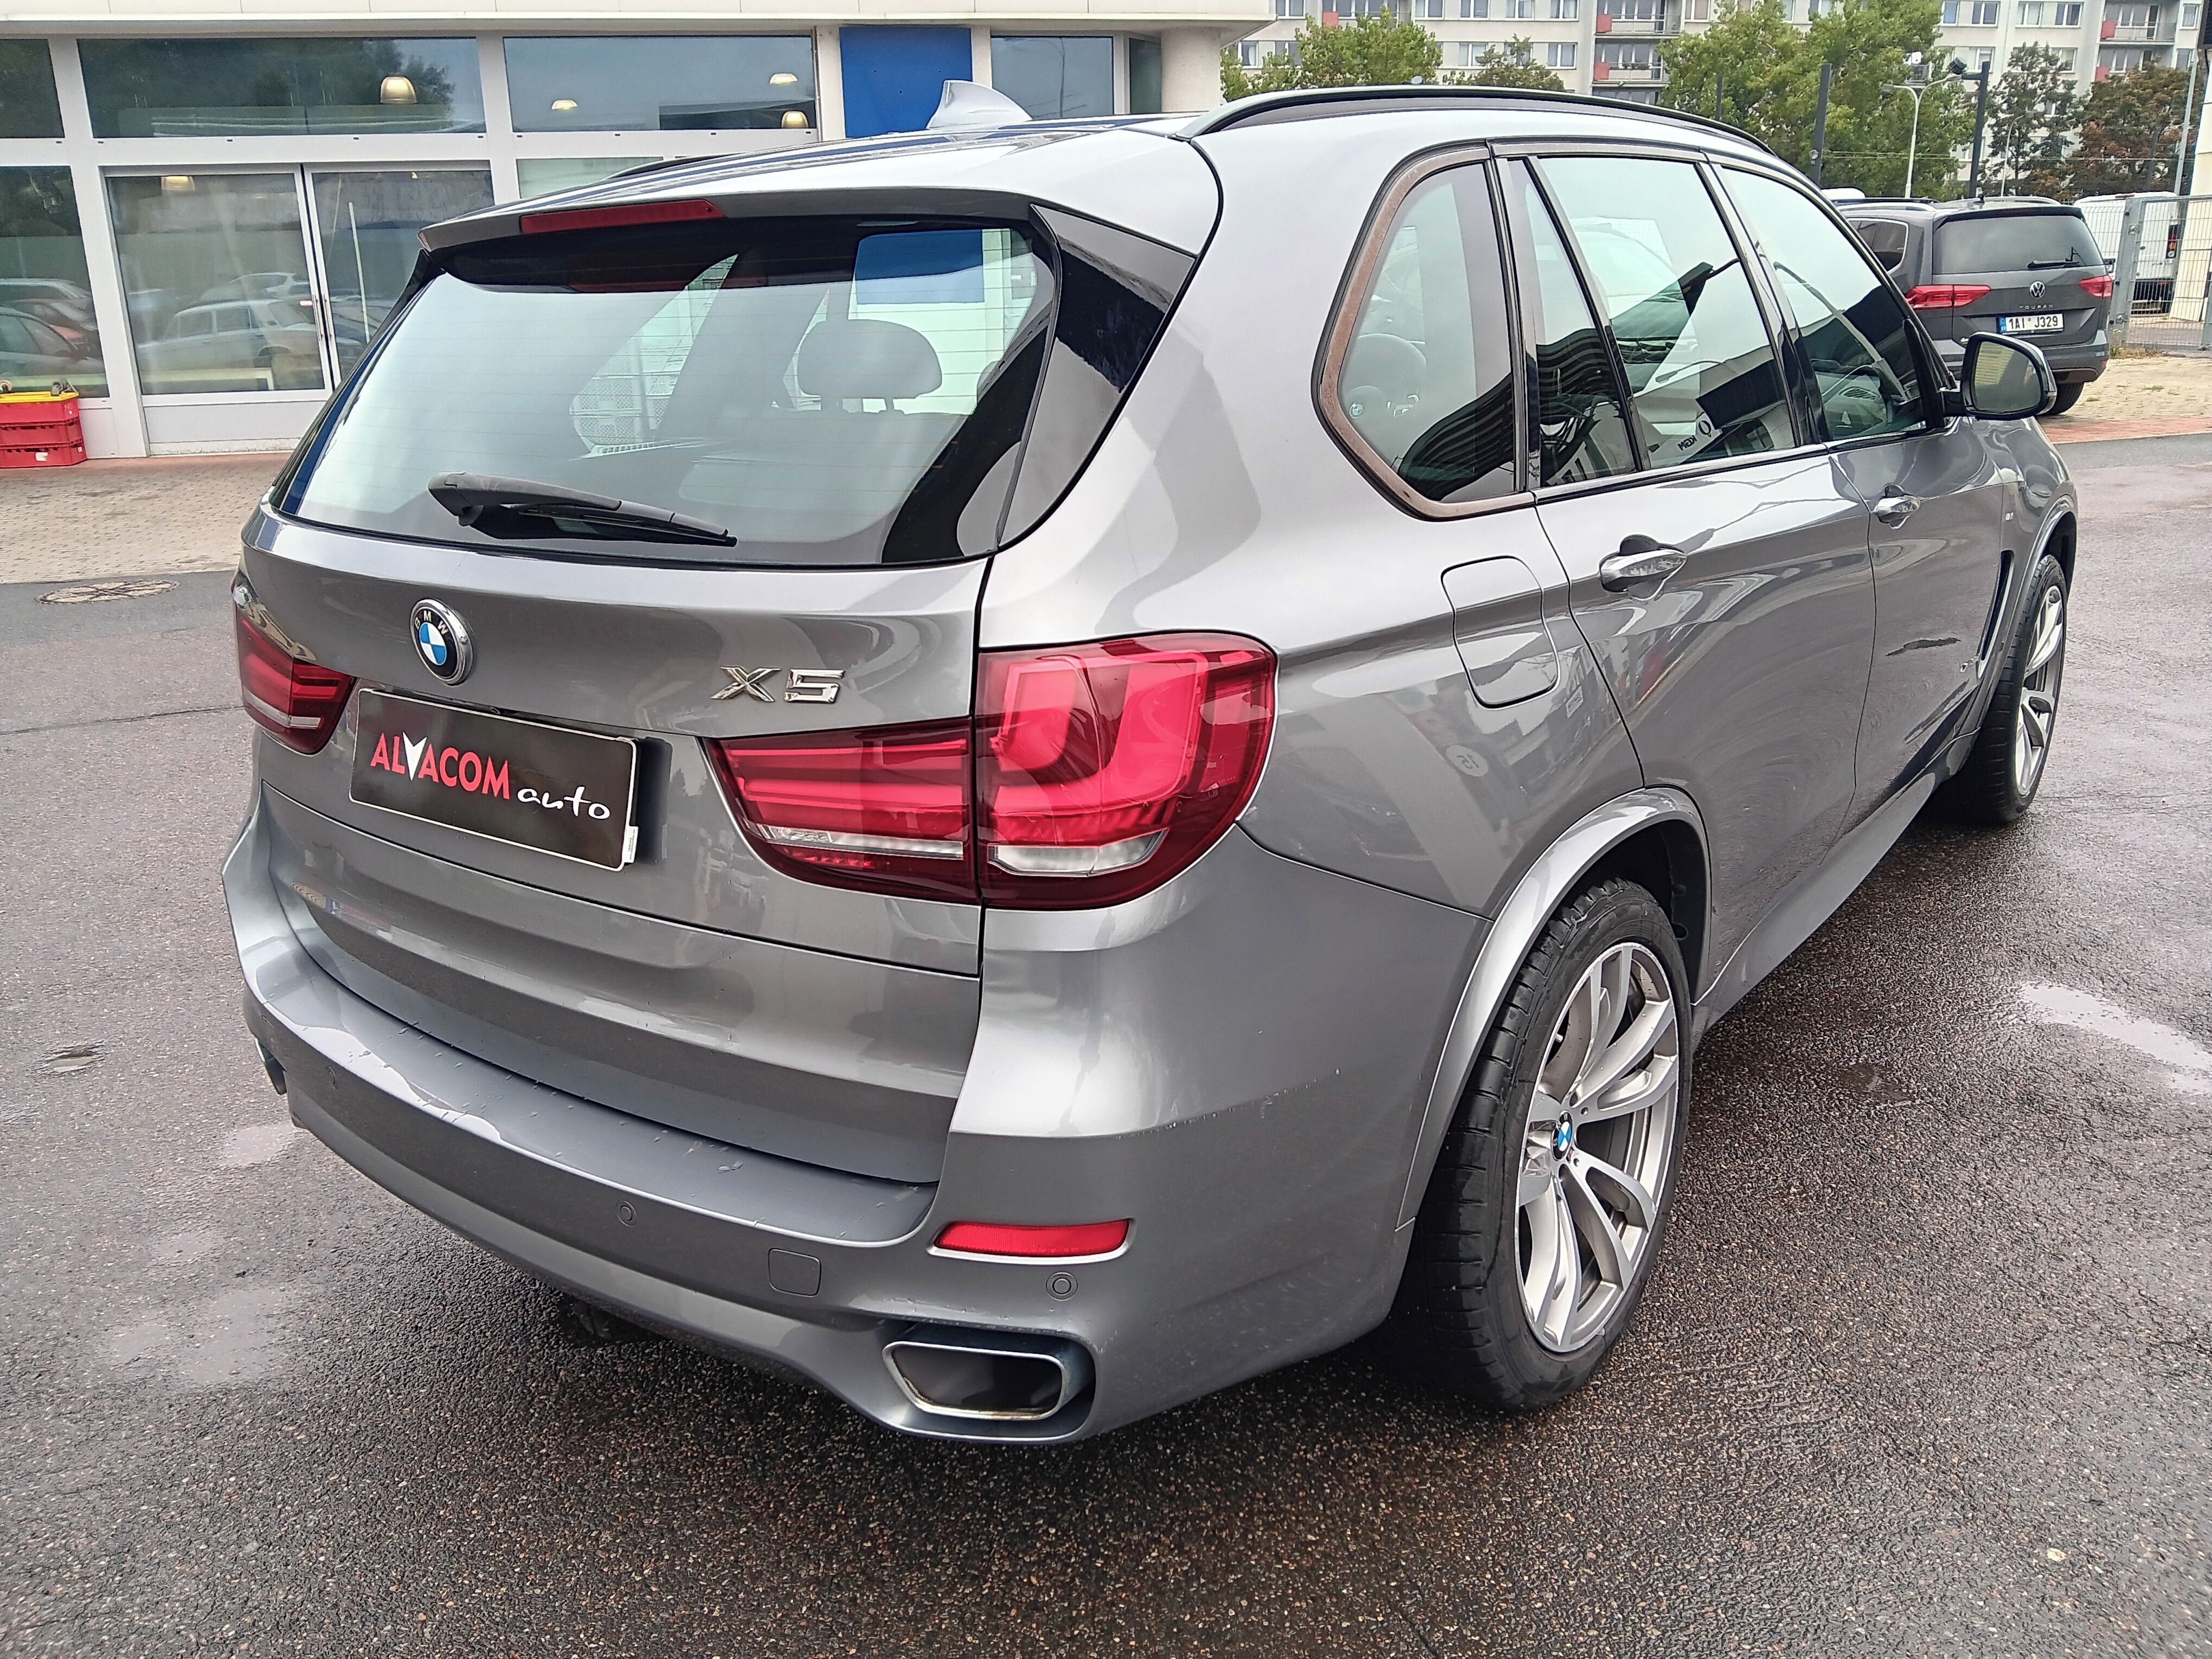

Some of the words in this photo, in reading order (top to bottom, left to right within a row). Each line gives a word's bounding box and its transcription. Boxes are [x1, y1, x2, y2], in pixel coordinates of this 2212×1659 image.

[2009, 317, 2025, 329] 1AI
[2034, 316, 2058, 328] J329
[414, 610, 449, 635] BMW
[710, 665, 846, 704] X5
[370, 731, 511, 800] ALVACOM
[517, 785, 611, 820] auto
